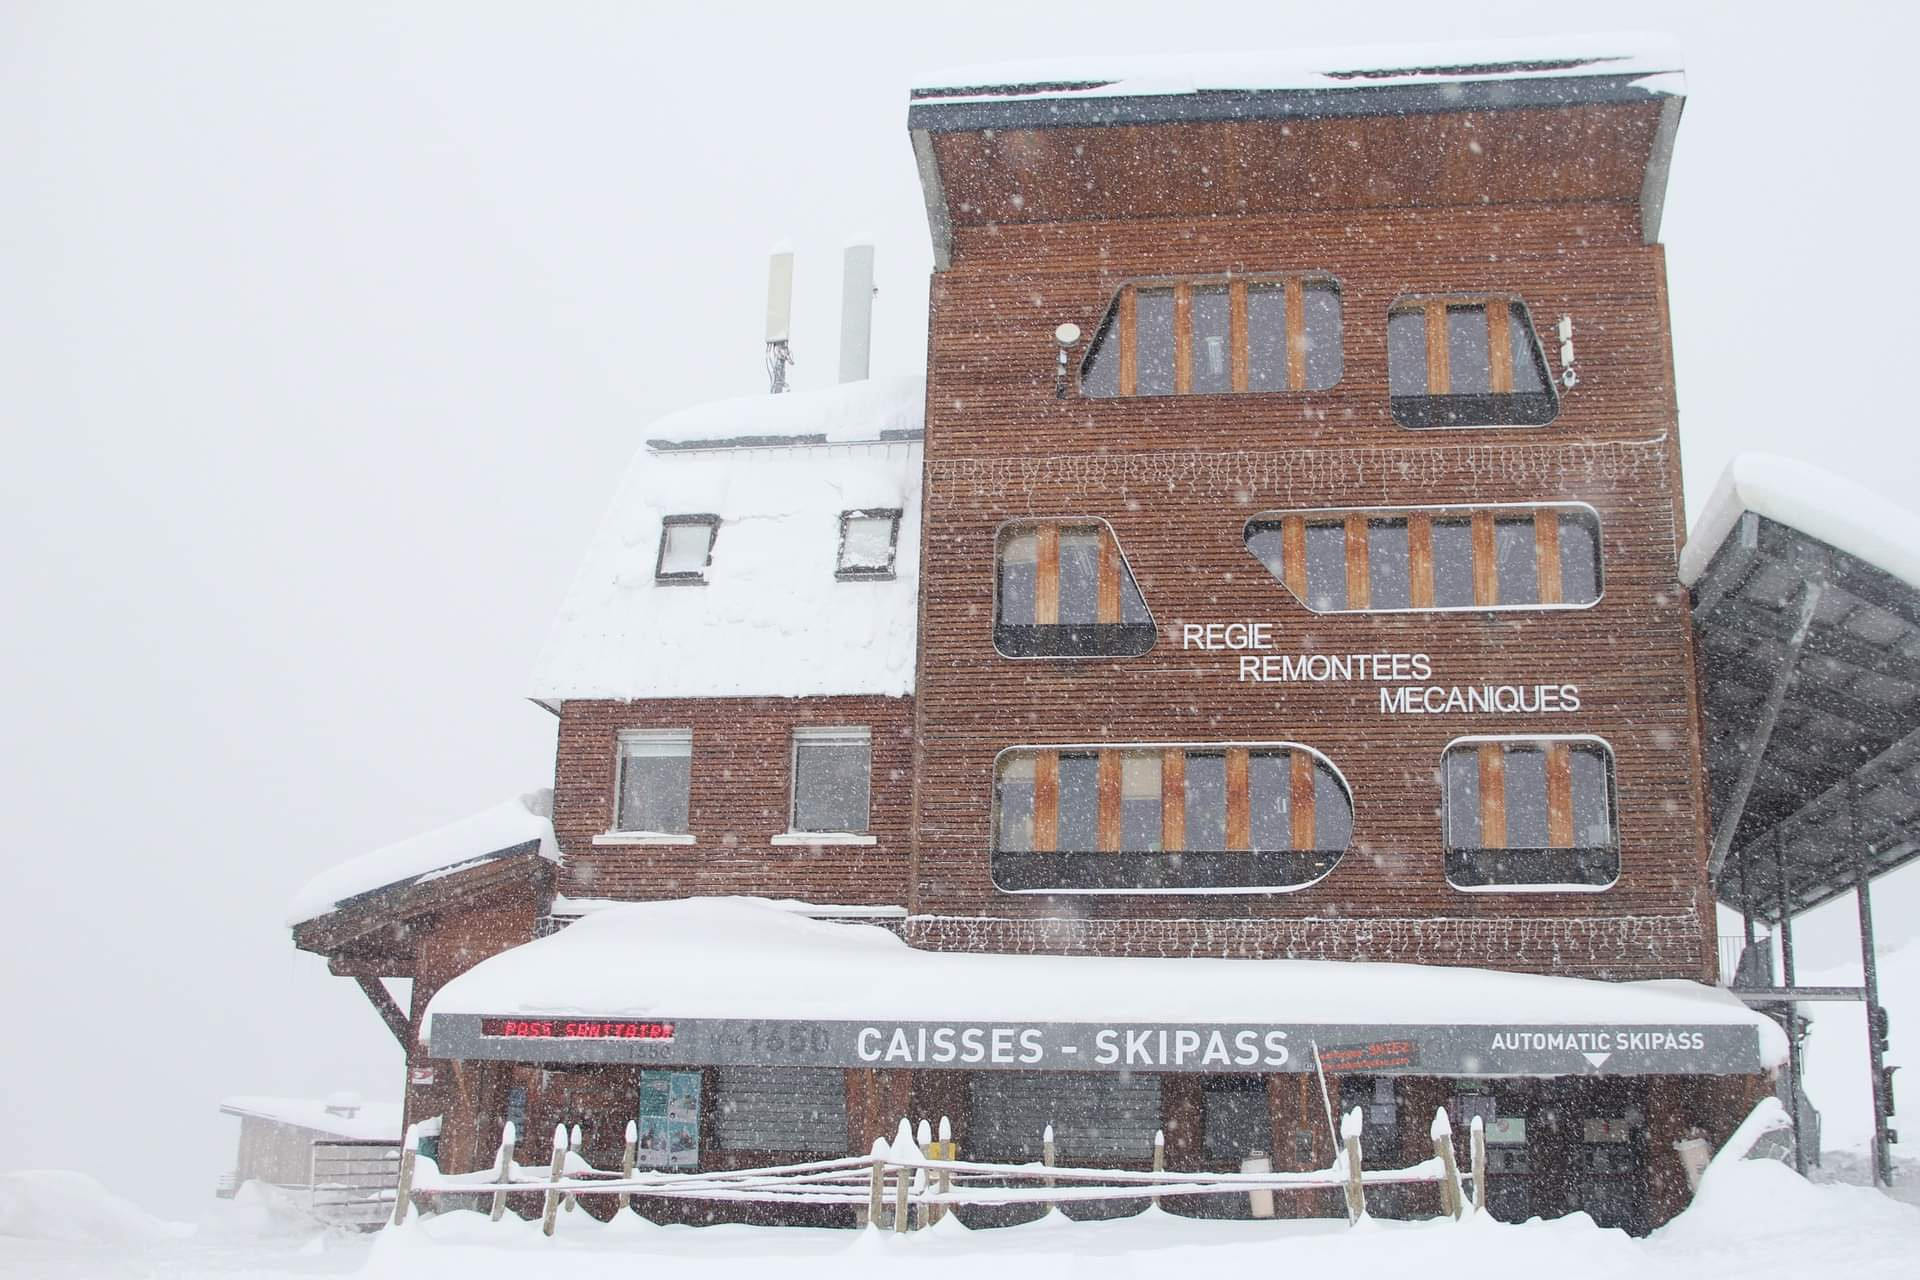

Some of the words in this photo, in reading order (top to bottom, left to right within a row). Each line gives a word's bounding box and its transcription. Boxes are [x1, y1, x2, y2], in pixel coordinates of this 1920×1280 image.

[1183, 623, 1273, 650] REGIE
[1240, 654, 1432, 682] REMONTEES
[1380, 684, 1581, 714] MECANIQUES
[857, 1027, 1044, 1063] CAISSES
[1094, 1030, 1289, 1065] SKIPASS
[1491, 1032, 1610, 1050] AUTOMATIC
[1616, 1032, 1705, 1050] SKIPASS
